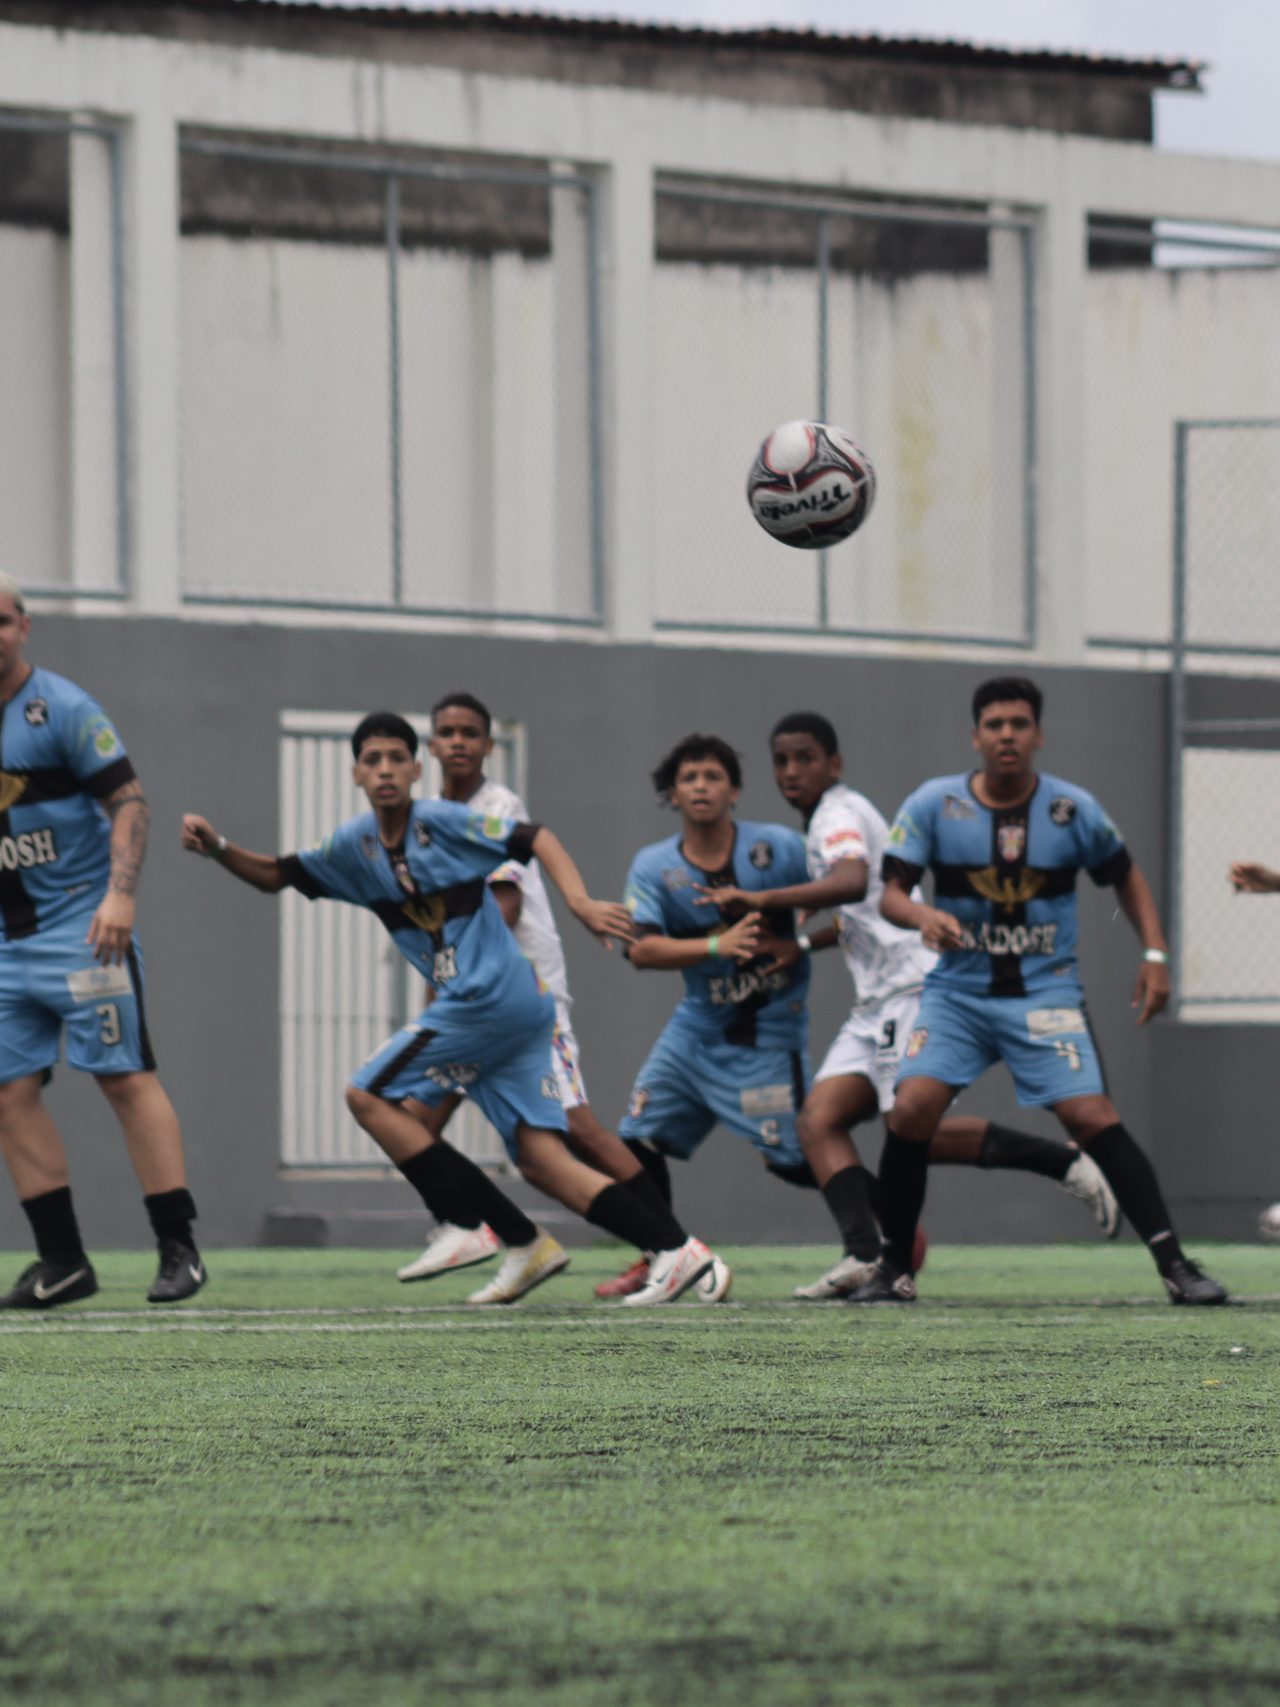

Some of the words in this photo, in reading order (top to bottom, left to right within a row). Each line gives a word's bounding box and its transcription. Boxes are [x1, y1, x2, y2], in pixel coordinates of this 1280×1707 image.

[0, 829, 57, 871] OSH
[96, 1003, 121, 1045] 3
[880, 1018, 897, 1050] 9
